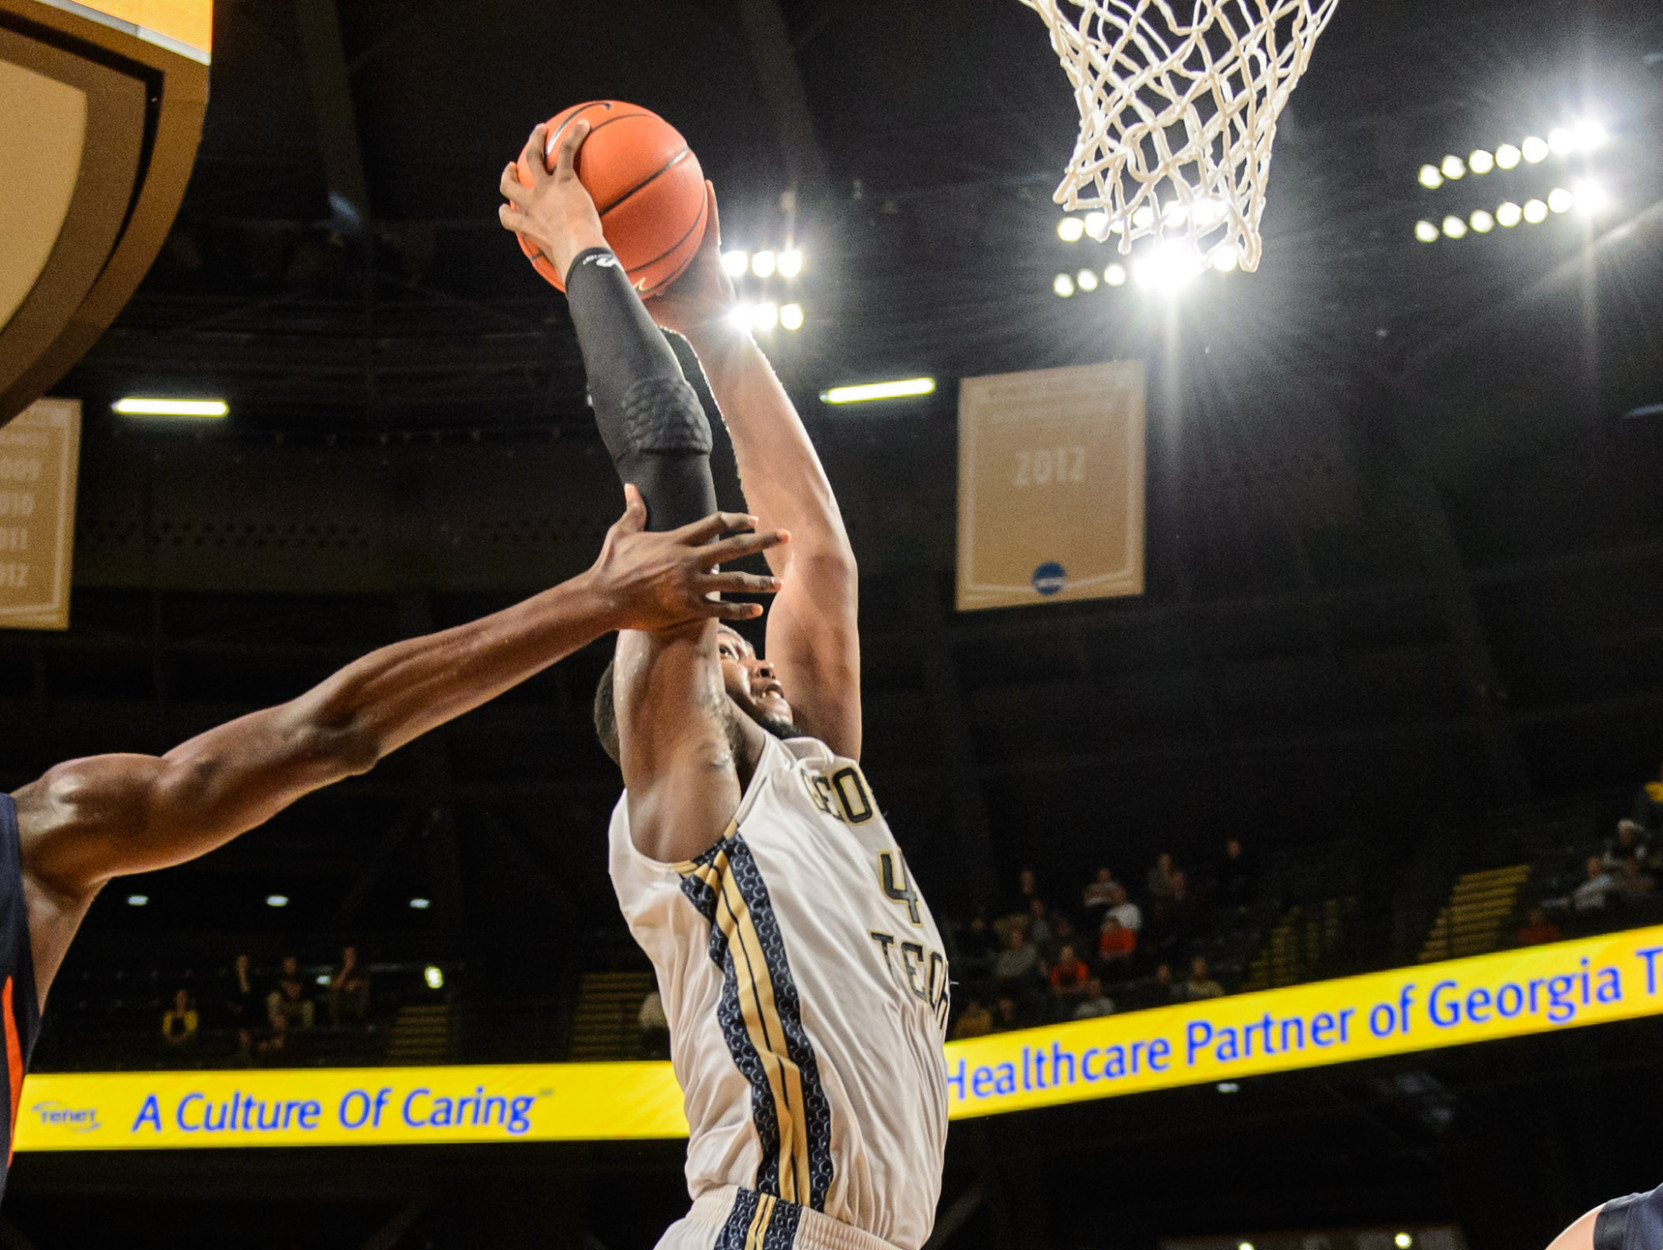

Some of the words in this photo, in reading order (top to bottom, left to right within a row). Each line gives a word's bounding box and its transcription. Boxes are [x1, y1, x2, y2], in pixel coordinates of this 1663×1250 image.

[1012, 446, 1086, 488] 2012
[878, 849, 922, 926] 4
[1186, 1007, 1355, 1067] Partner
[1368, 983, 1416, 1038] of
[1428, 956, 1622, 1025] Georgia
[131, 1092, 162, 1133] A
[176, 1089, 322, 1133] Culture
[338, 1086, 393, 1129] Of
[402, 1084, 538, 1135] Caring
